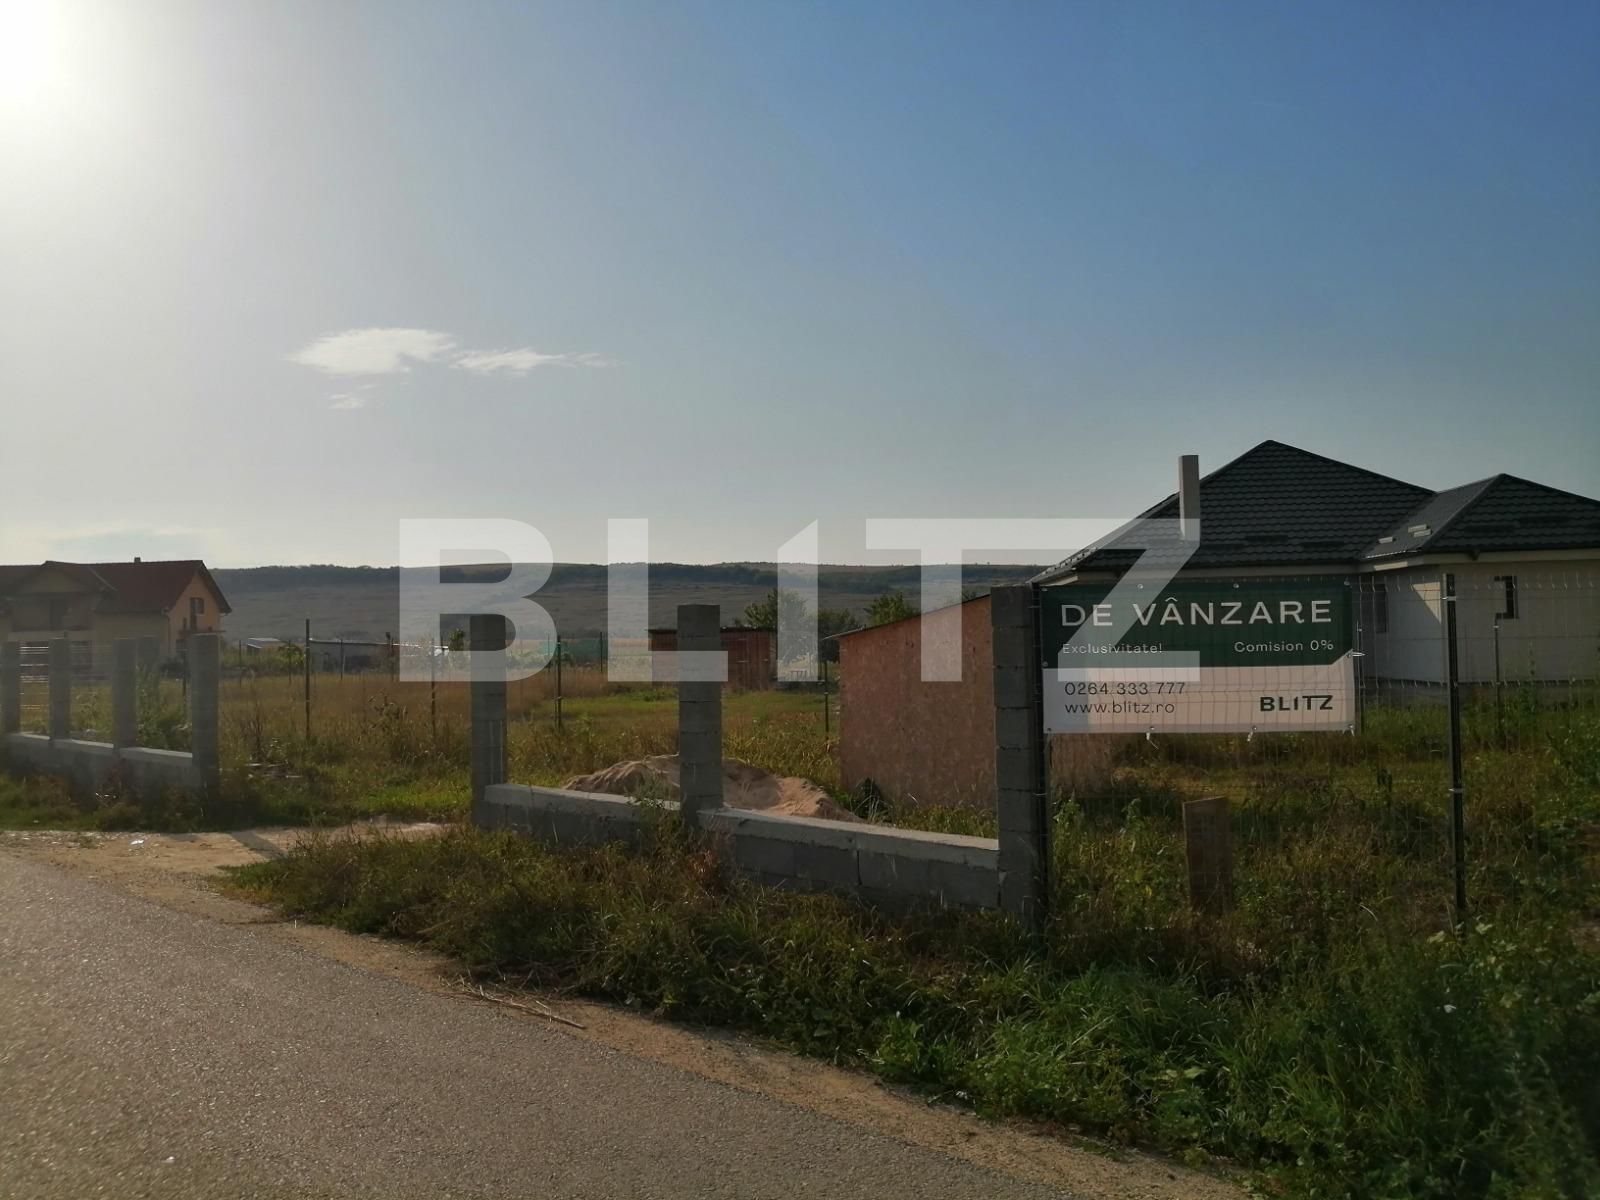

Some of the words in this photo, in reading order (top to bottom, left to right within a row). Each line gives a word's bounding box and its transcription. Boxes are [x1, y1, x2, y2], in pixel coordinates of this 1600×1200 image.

[1061, 603, 1113, 627] DE
[1132, 596, 1332, 627] VÂNZARE
[1062, 642, 1163, 655] Exclusivitate!
[1234, 640, 1303, 653] Comision
[1310, 639, 1334, 651] 0%
[1065, 682, 1108, 695] 0264
[1116, 682, 1149, 695] 333
[1156, 682, 1186, 695] 777
[1064, 700, 1175, 714] www.blitz.ro
[1259, 694, 1334, 712] BLITZ
